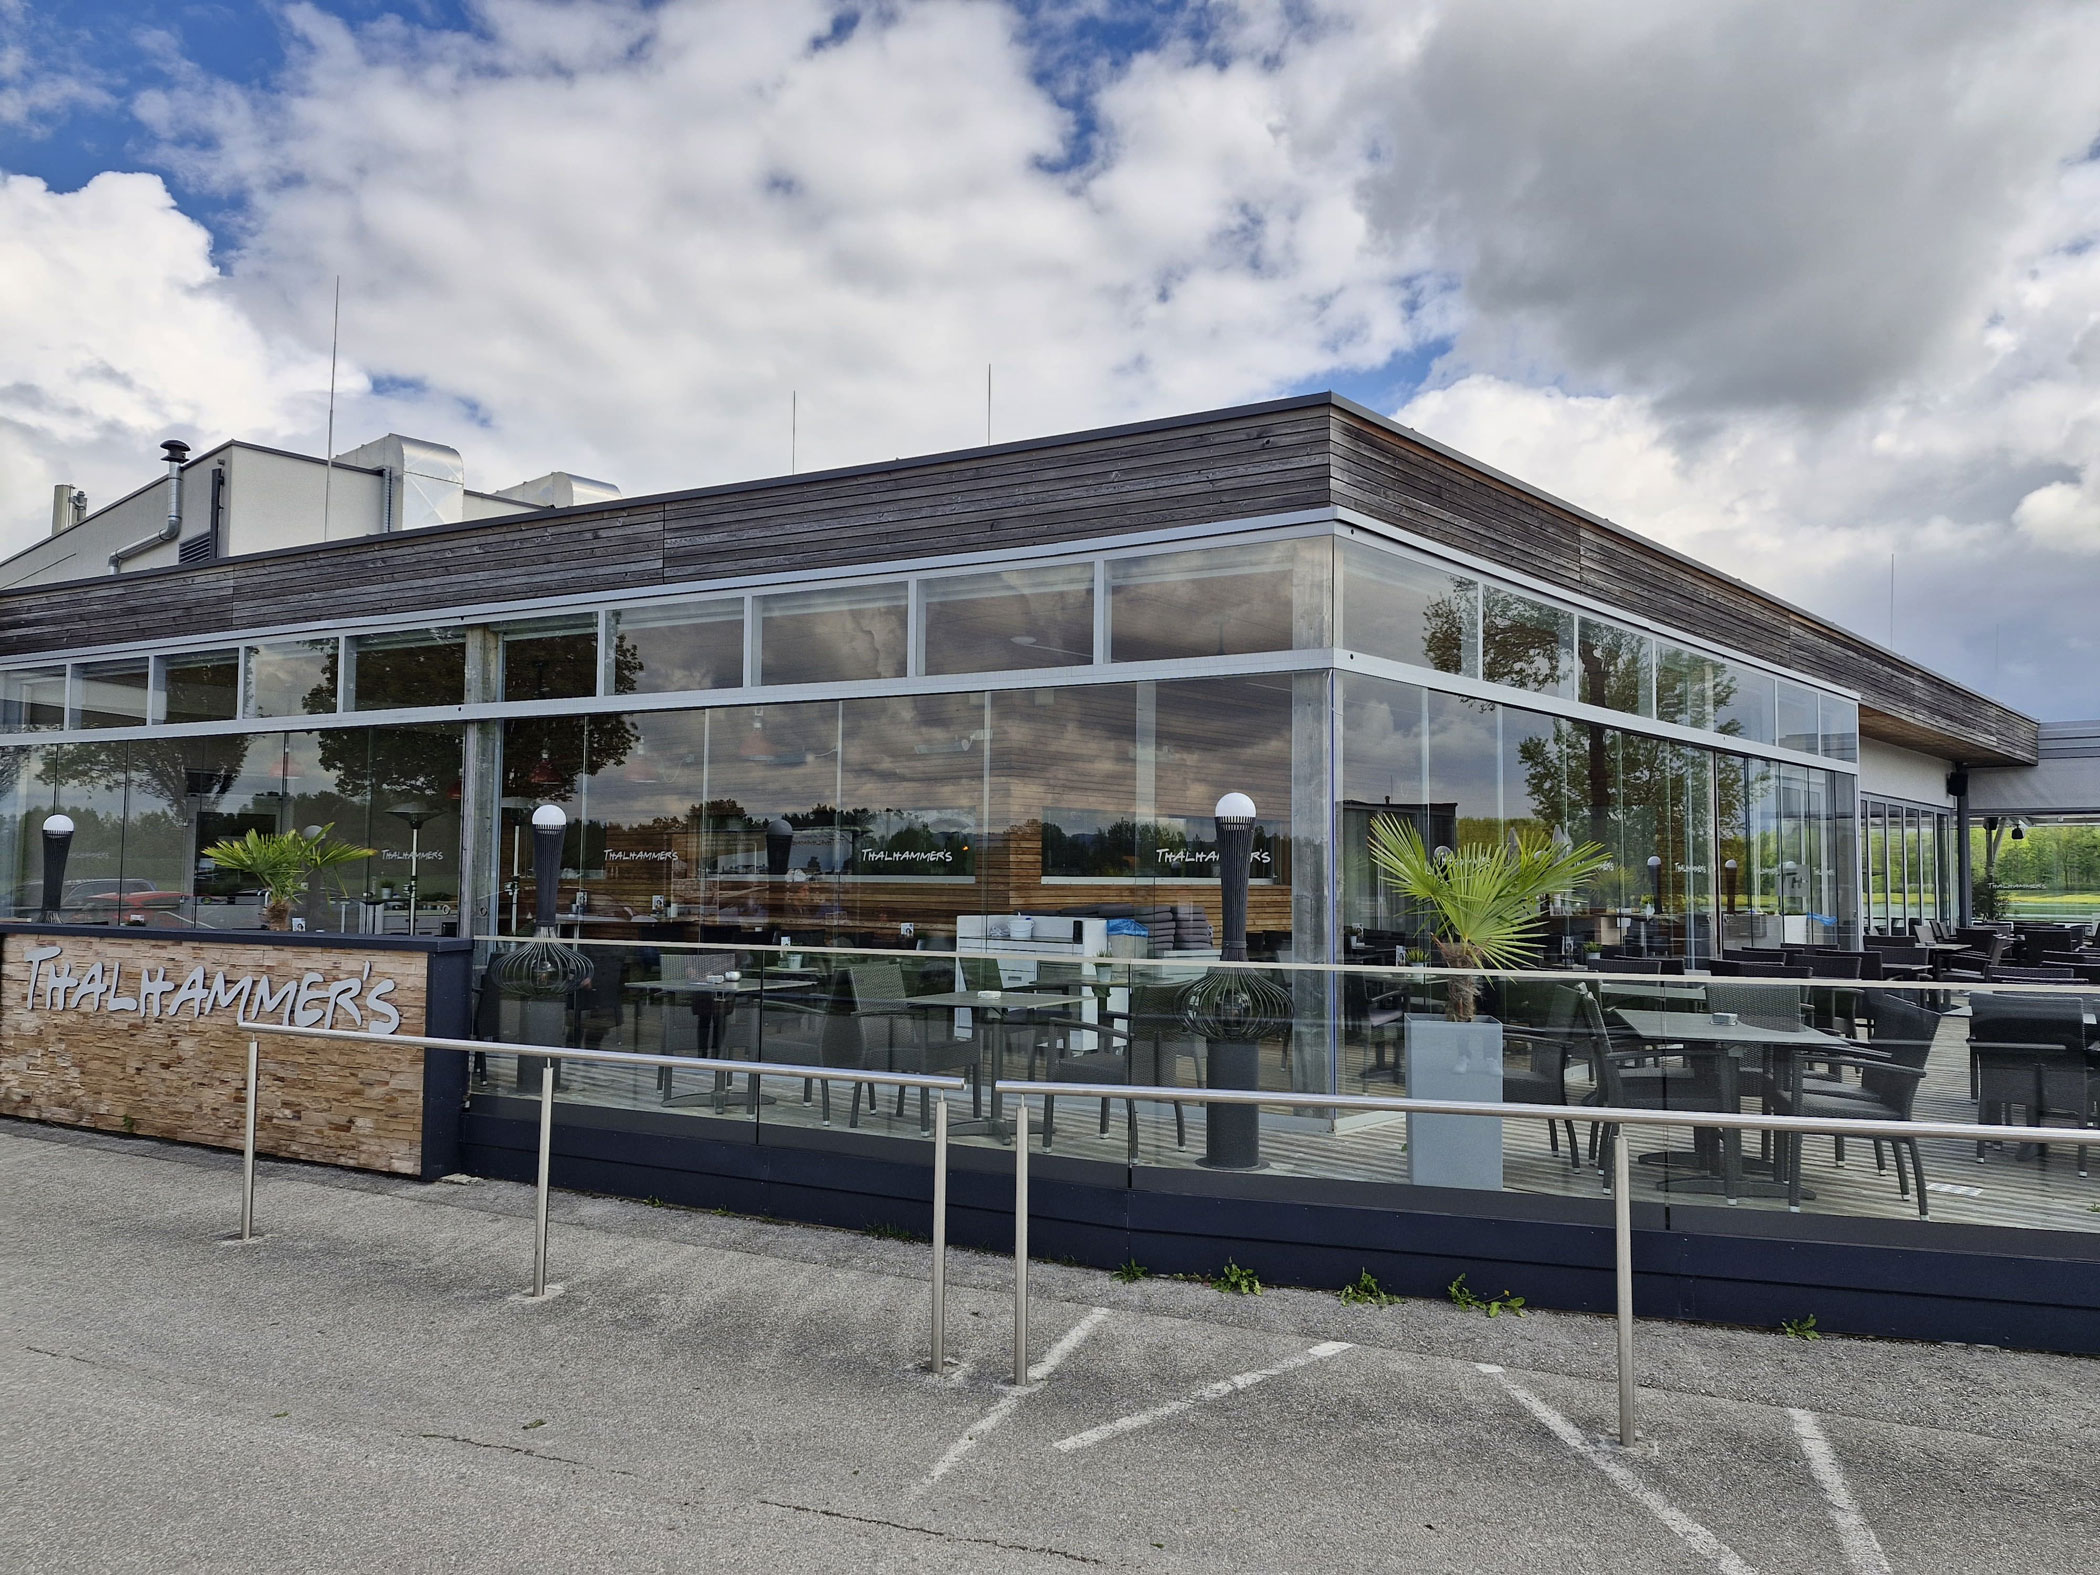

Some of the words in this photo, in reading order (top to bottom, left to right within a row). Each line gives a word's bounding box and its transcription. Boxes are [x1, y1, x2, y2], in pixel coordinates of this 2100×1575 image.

[603, 848, 679, 861] THALHAMMER'S
[861, 848, 953, 862] THALHAMMER'S
[1156, 848, 1271, 863] THALHAR'S
[24, 945, 401, 1035] THALHAMMER'S
